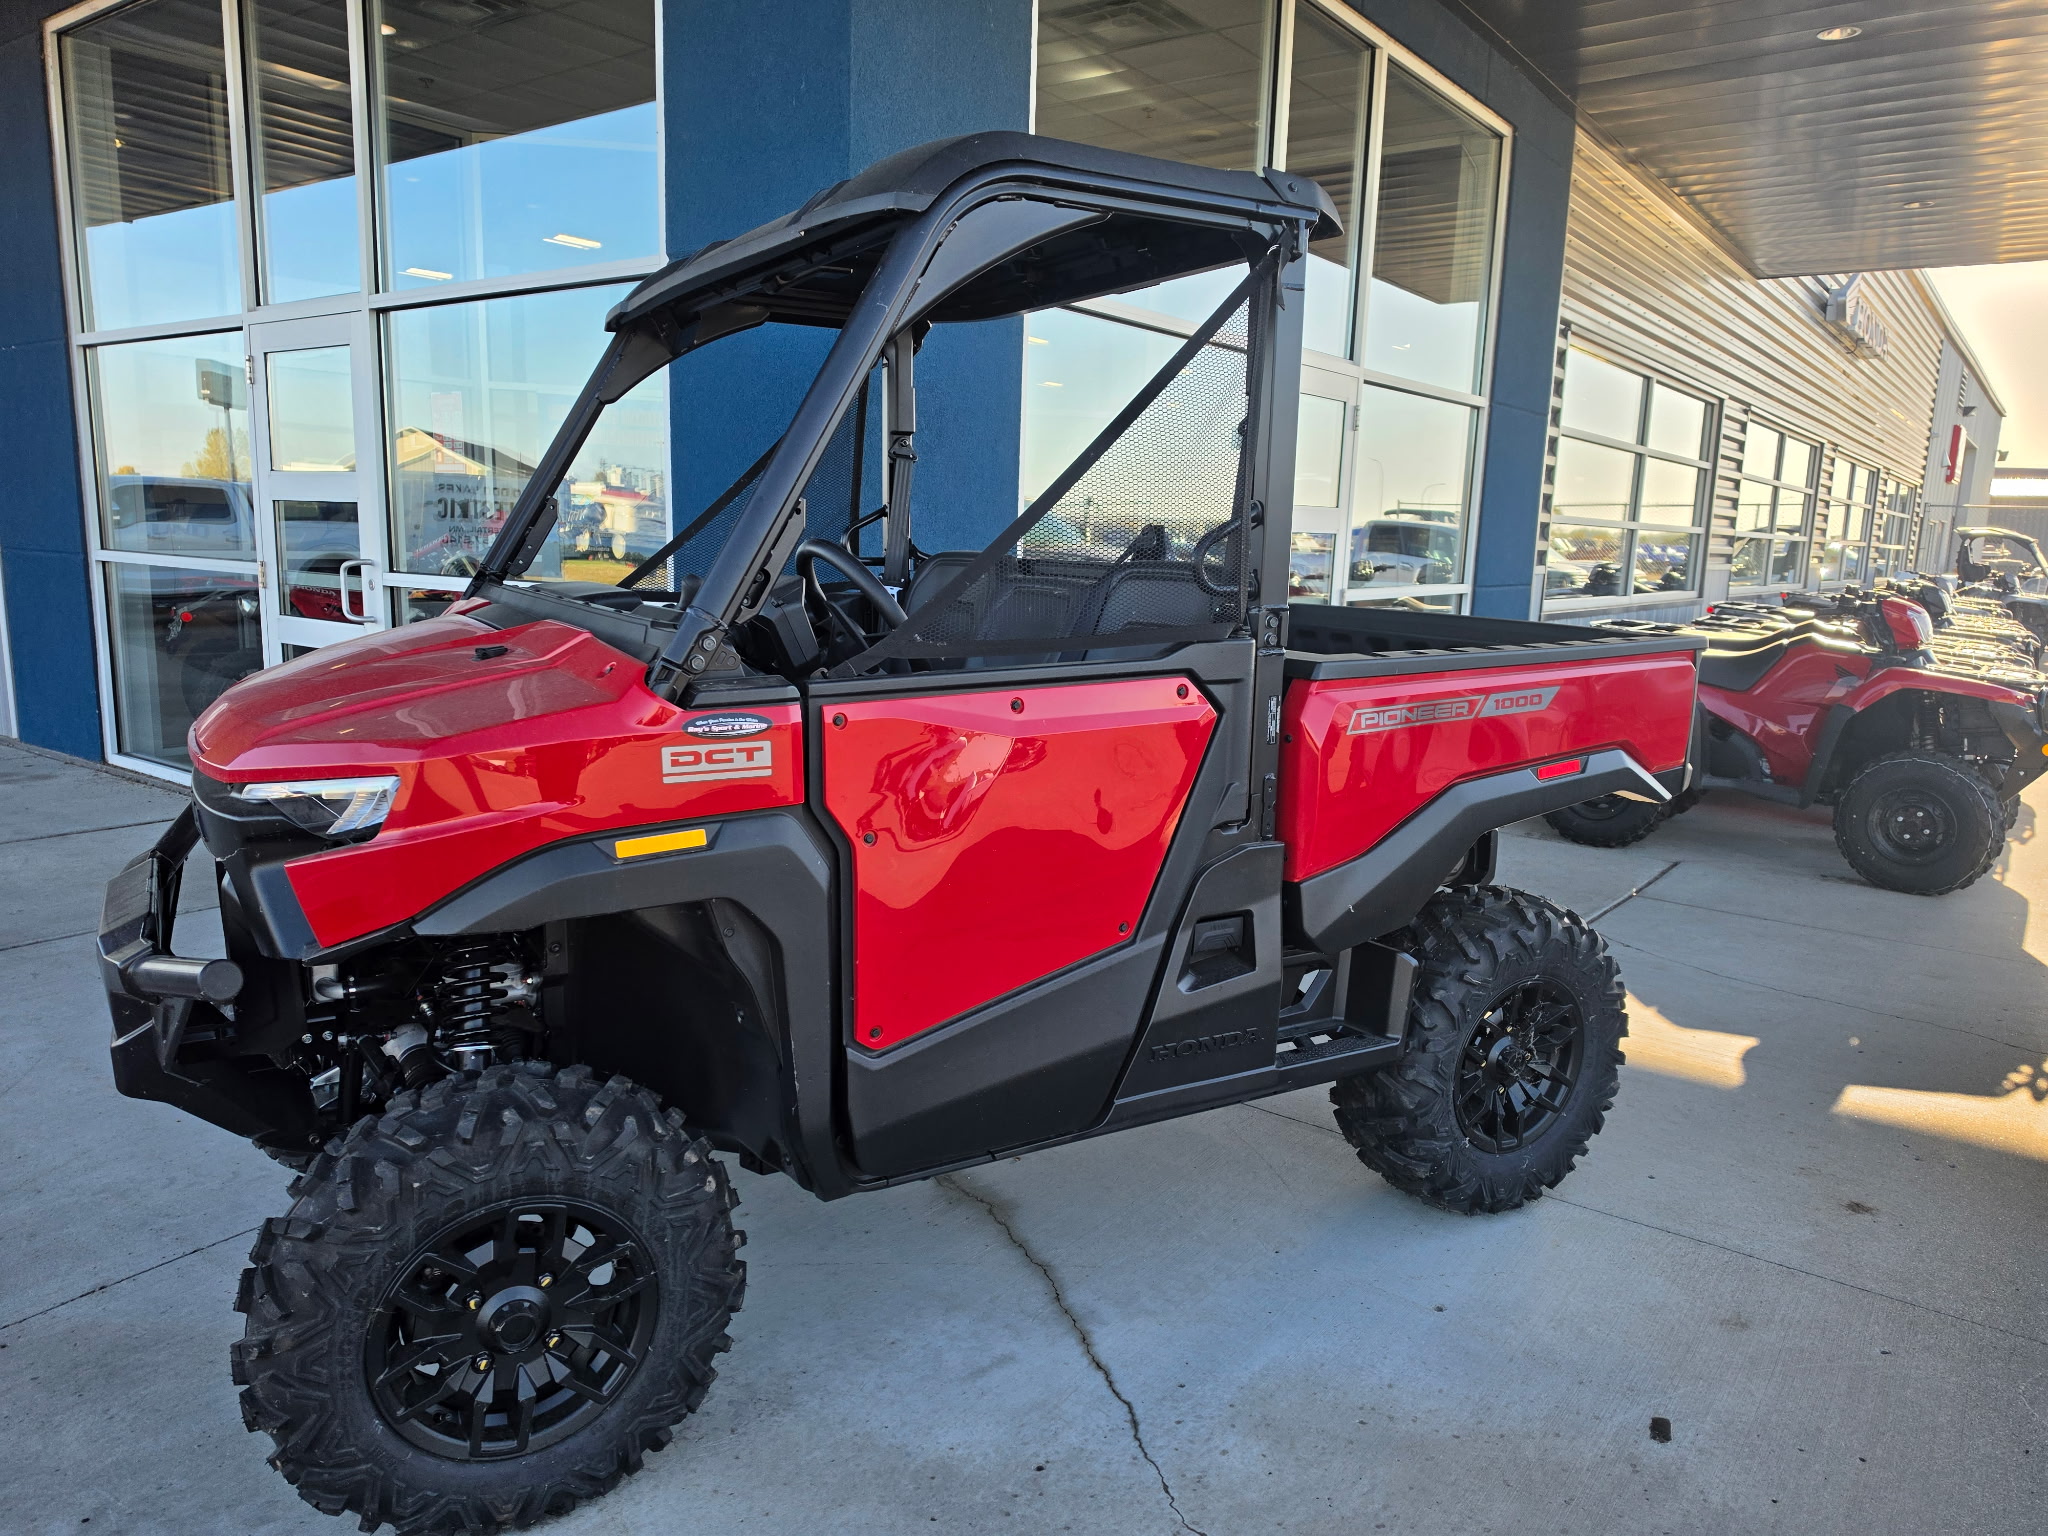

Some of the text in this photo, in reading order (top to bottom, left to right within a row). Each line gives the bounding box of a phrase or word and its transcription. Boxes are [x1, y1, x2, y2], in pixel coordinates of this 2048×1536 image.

[1361, 693, 1543, 729] PIONEER 1000
[710, 724, 733, 732] Sport
[742, 722, 768, 730] Marine
[670, 746, 764, 767] DCT
[1149, 1027, 1259, 1062] HONDA
